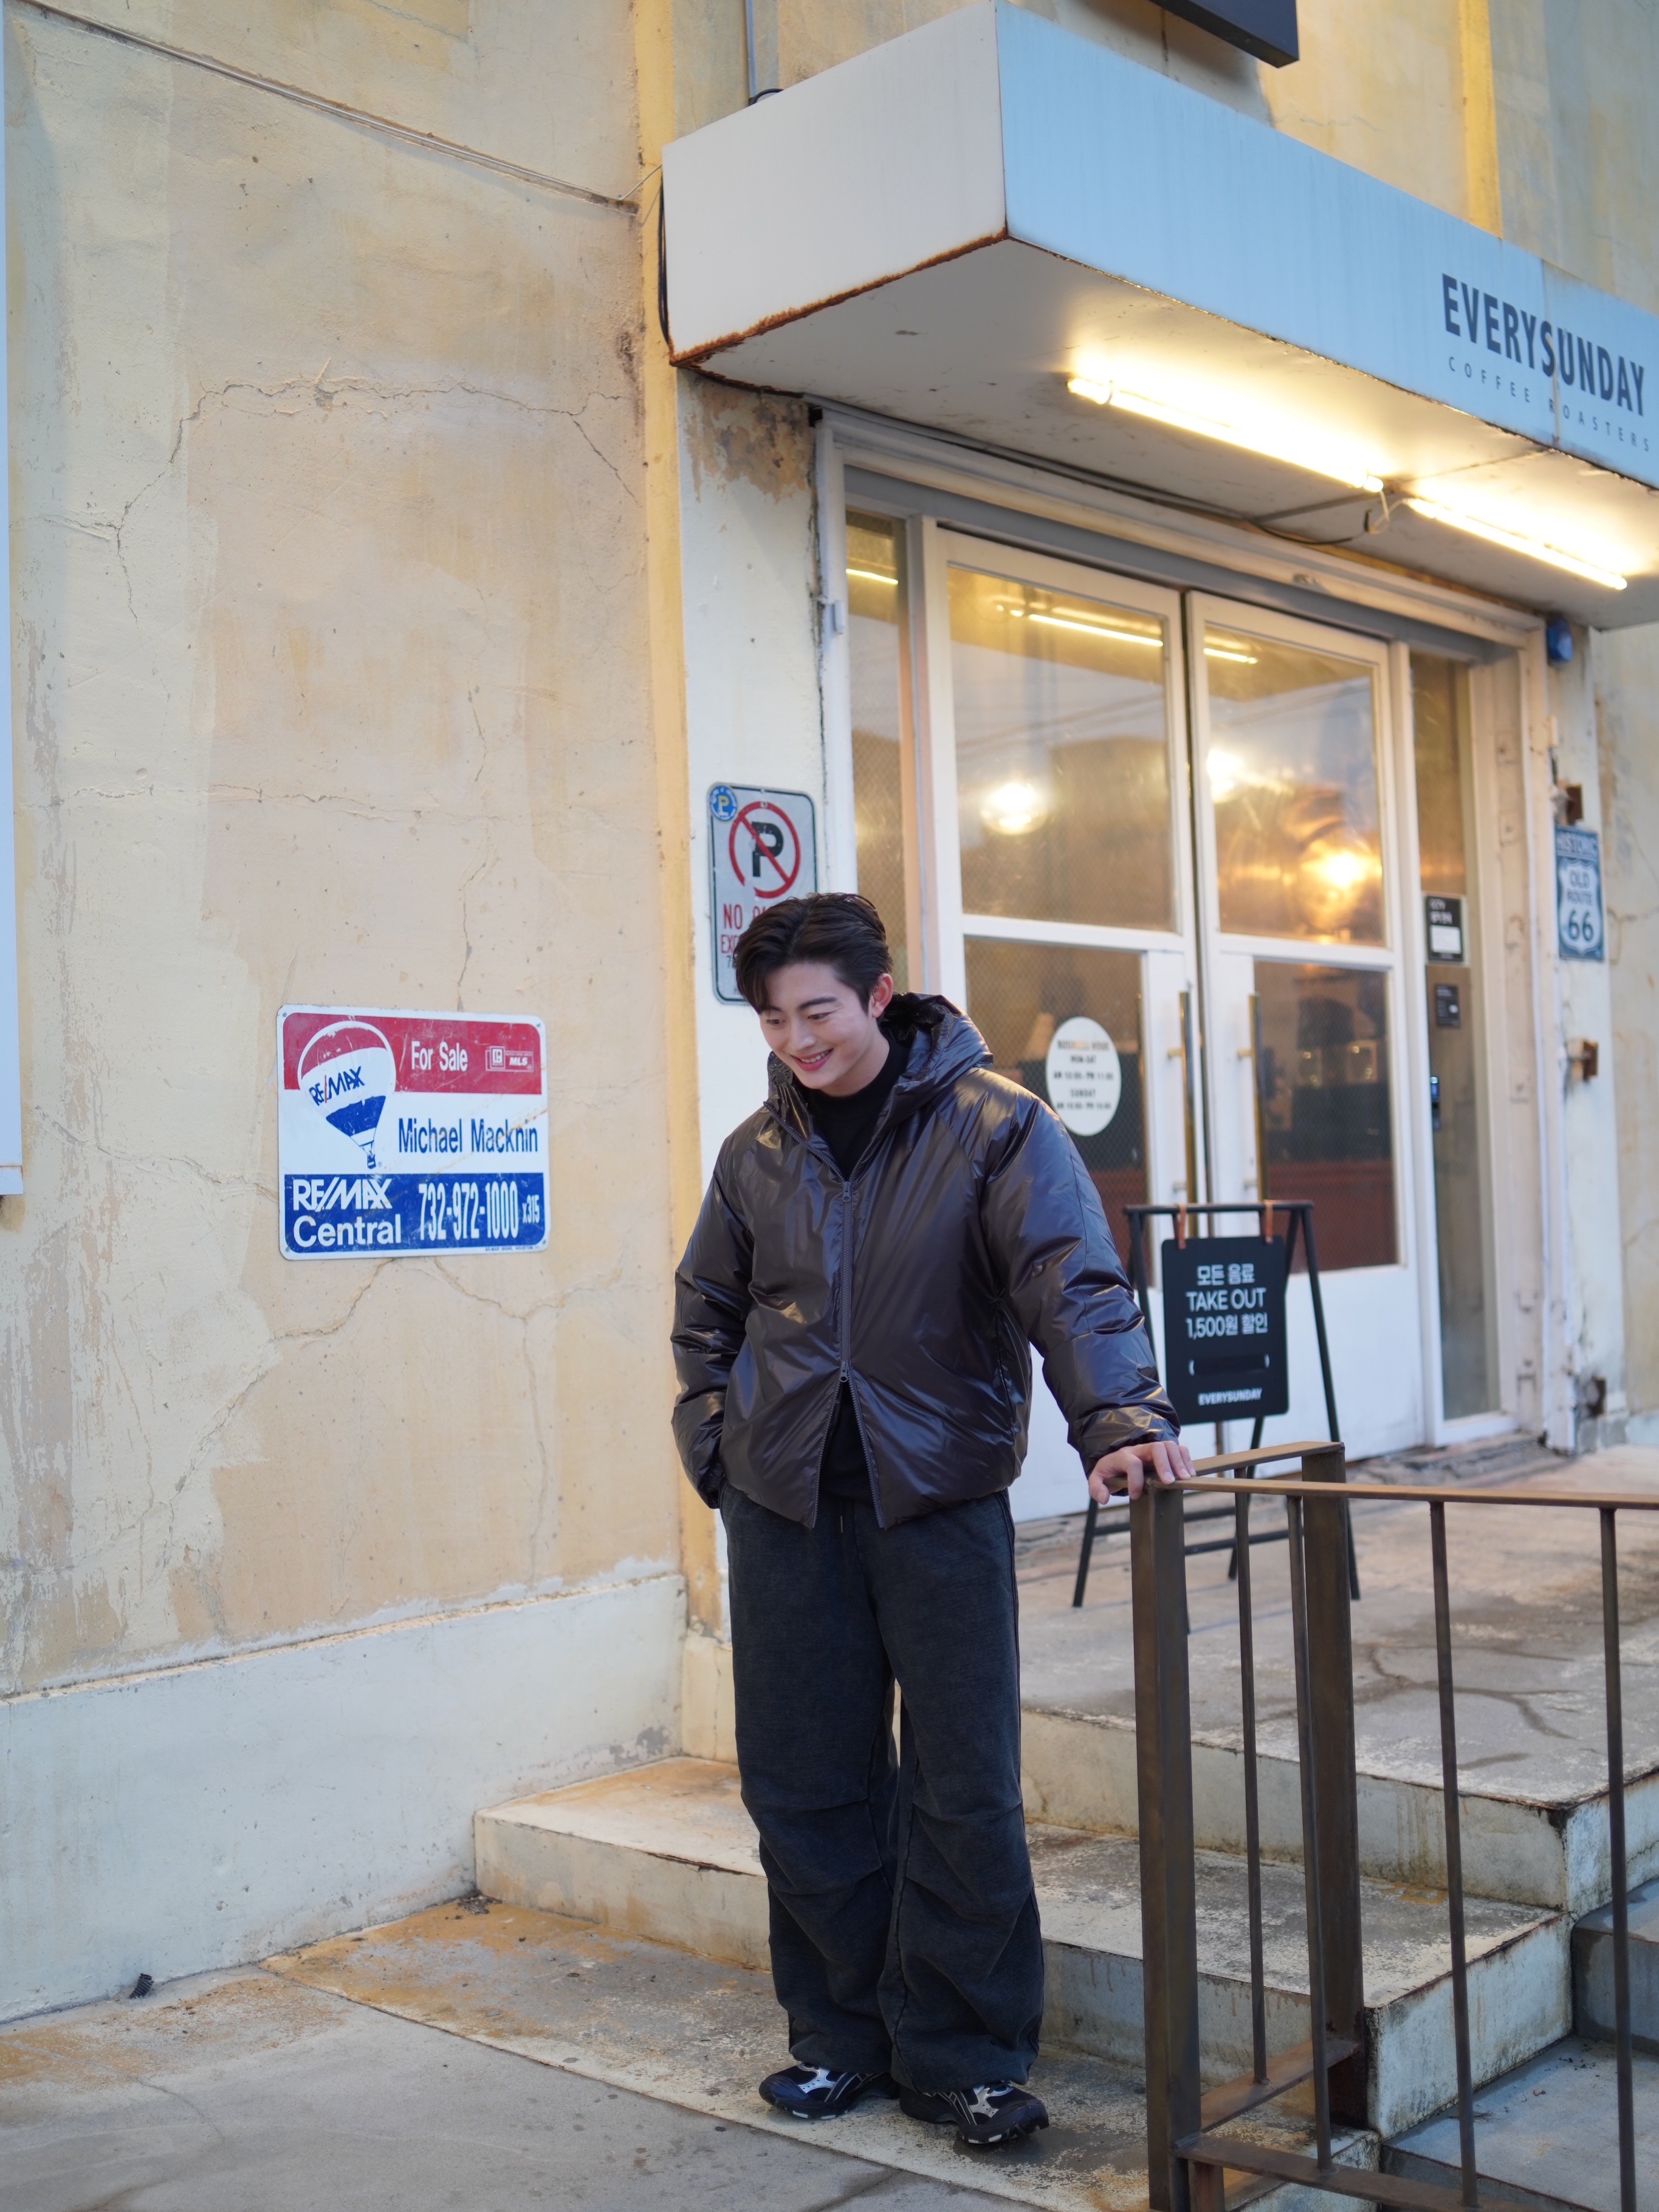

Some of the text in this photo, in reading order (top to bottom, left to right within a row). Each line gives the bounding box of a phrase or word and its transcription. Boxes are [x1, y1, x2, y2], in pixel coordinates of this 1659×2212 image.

[1441, 273, 1644, 417] EVERYSUNDAY
[1448, 356, 1650, 452] COFFEE ROASTERS
[1570, 871, 1590, 888] OLD
[1567, 890, 1593, 906] ROUTE
[723, 903, 743, 930] NO
[1567, 908, 1594, 942] 66
[411, 1041, 468, 1072] For Sale
[509, 1056, 528, 1066] MLS
[309, 1066, 365, 1106] RE/MAX
[398, 1118, 538, 1153] Michael Macknin
[293, 1177, 393, 1212] RE/MAX
[418, 1181, 519, 1241] 732-972-1000
[294, 1214, 401, 1248] Central
[1197, 1263, 1255, 1286] 모든 음료
[1186, 1287, 1266, 1312] TAKE OUT
[1186, 1312, 1269, 1340] 1,500원 할인
[1198, 1388, 1263, 1406] EVERYSUNDAY
